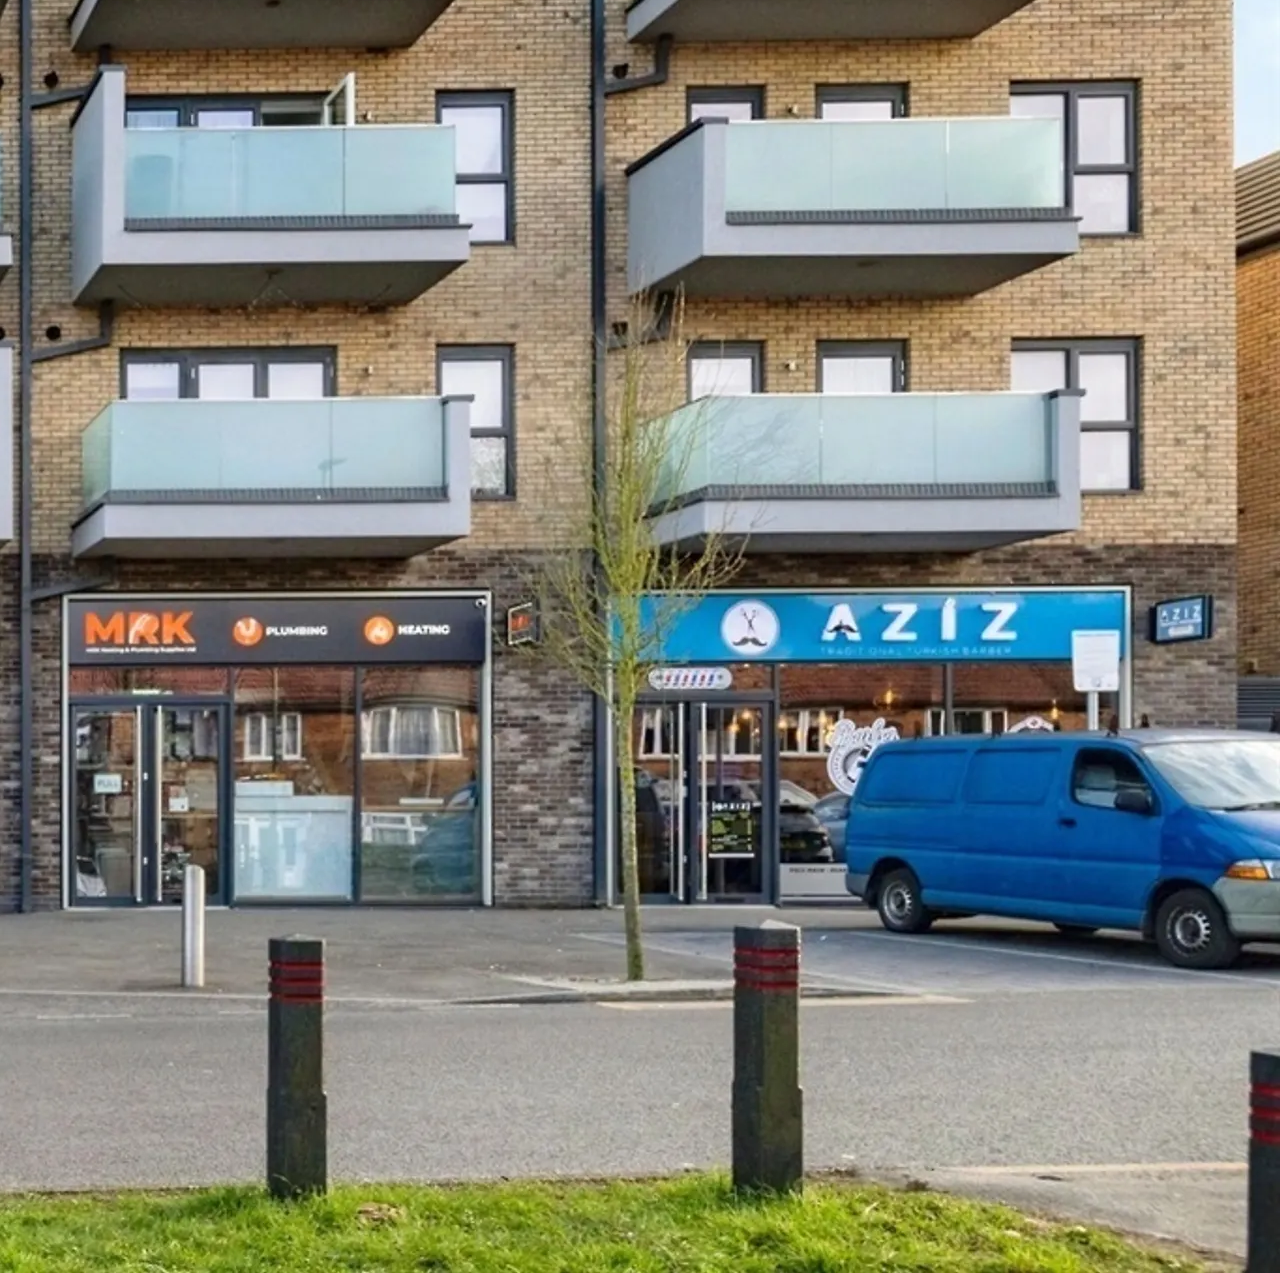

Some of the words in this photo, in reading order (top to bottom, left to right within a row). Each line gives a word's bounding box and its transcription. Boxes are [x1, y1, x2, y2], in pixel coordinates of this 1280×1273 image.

[85, 610, 196, 644] MRK
[265, 625, 328, 637] PLUMBING
[397, 624, 450, 635] HEATING
[906, 646, 959, 656] TURKISH
[962, 646, 1012, 655] BARBER
